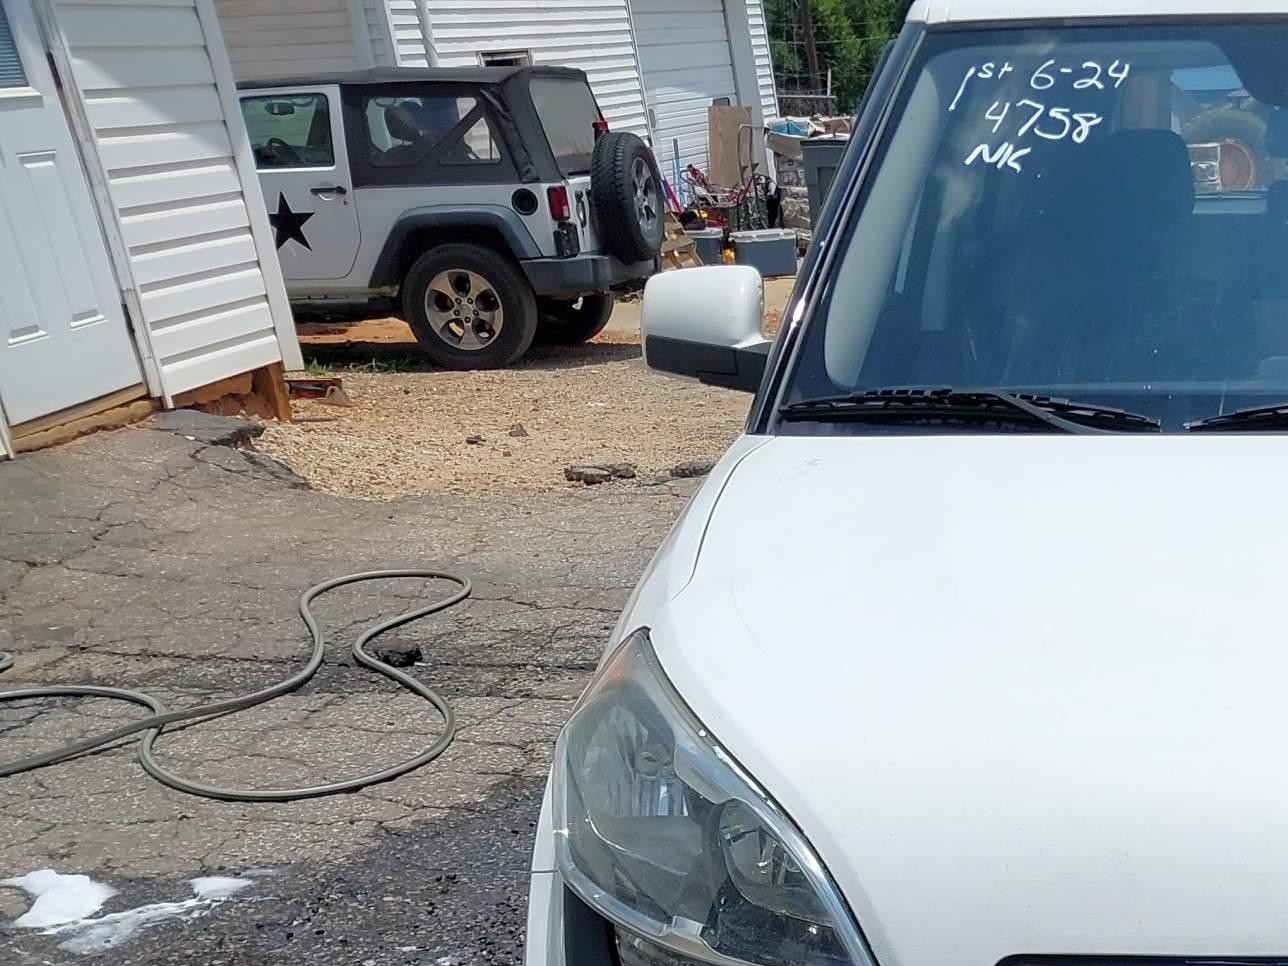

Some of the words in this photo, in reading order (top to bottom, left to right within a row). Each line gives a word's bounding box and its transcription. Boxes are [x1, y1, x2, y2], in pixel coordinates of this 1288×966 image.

[949, 62, 1012, 112] 1st
[1030, 59, 1130, 90] 6-24
[984, 99, 1102, 144] 4758
